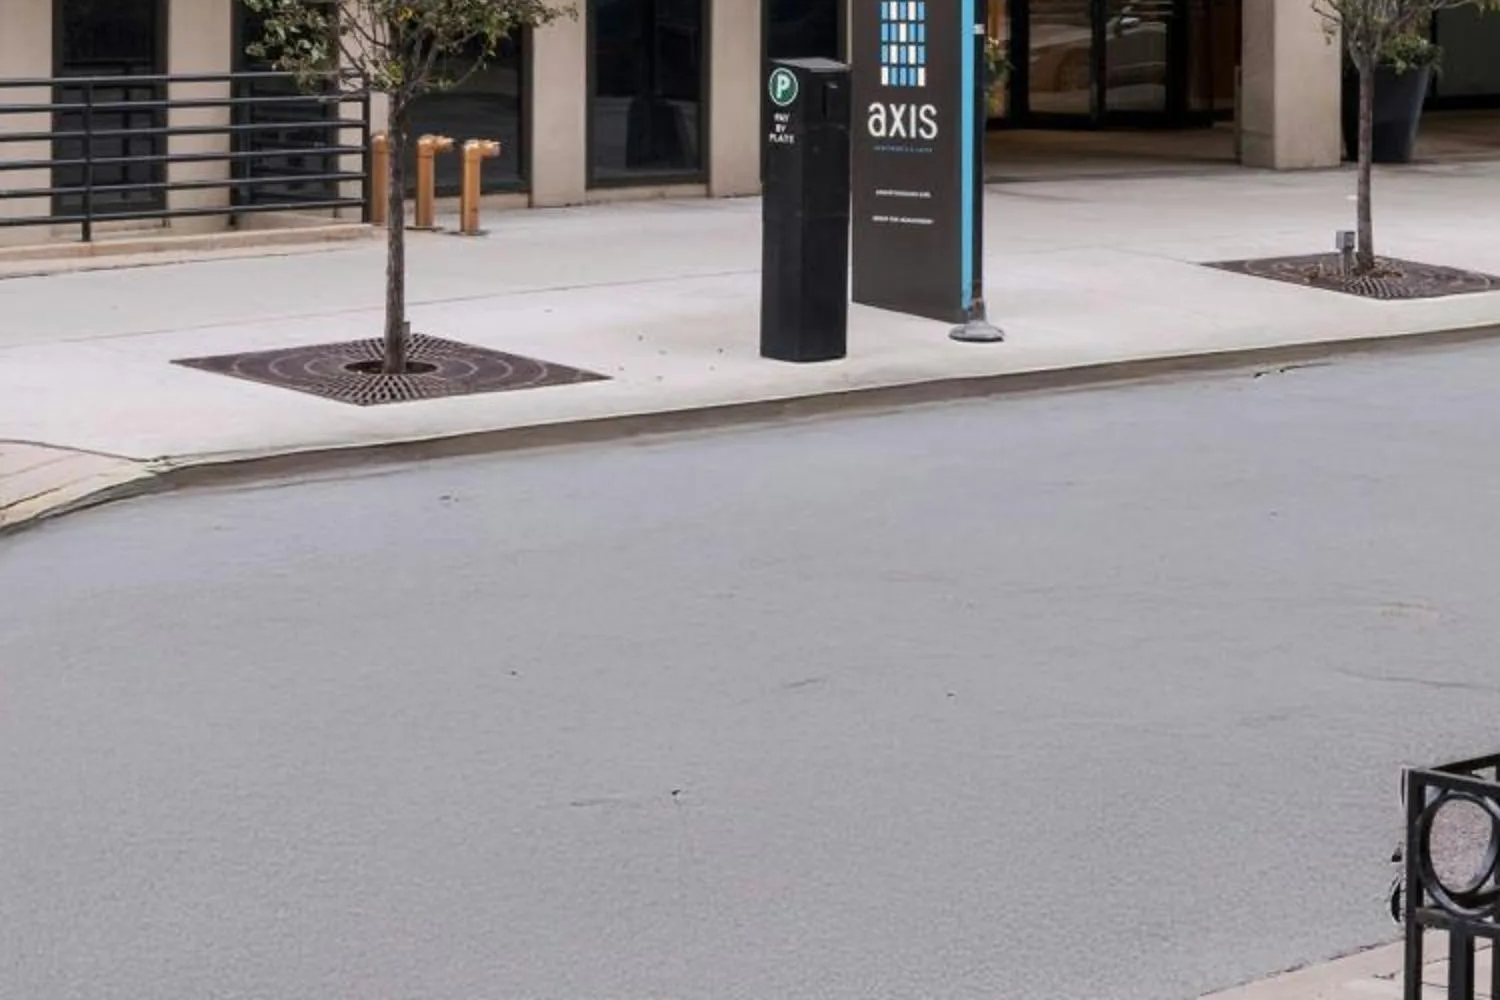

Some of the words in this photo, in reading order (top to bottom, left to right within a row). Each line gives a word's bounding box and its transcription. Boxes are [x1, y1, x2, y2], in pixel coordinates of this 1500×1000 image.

[776, 74, 791, 99] P
[774, 112, 790, 123] PAY
[868, 102, 938, 140] axis
[775, 123, 787, 133] BY
[769, 133, 795, 144] PLATE
